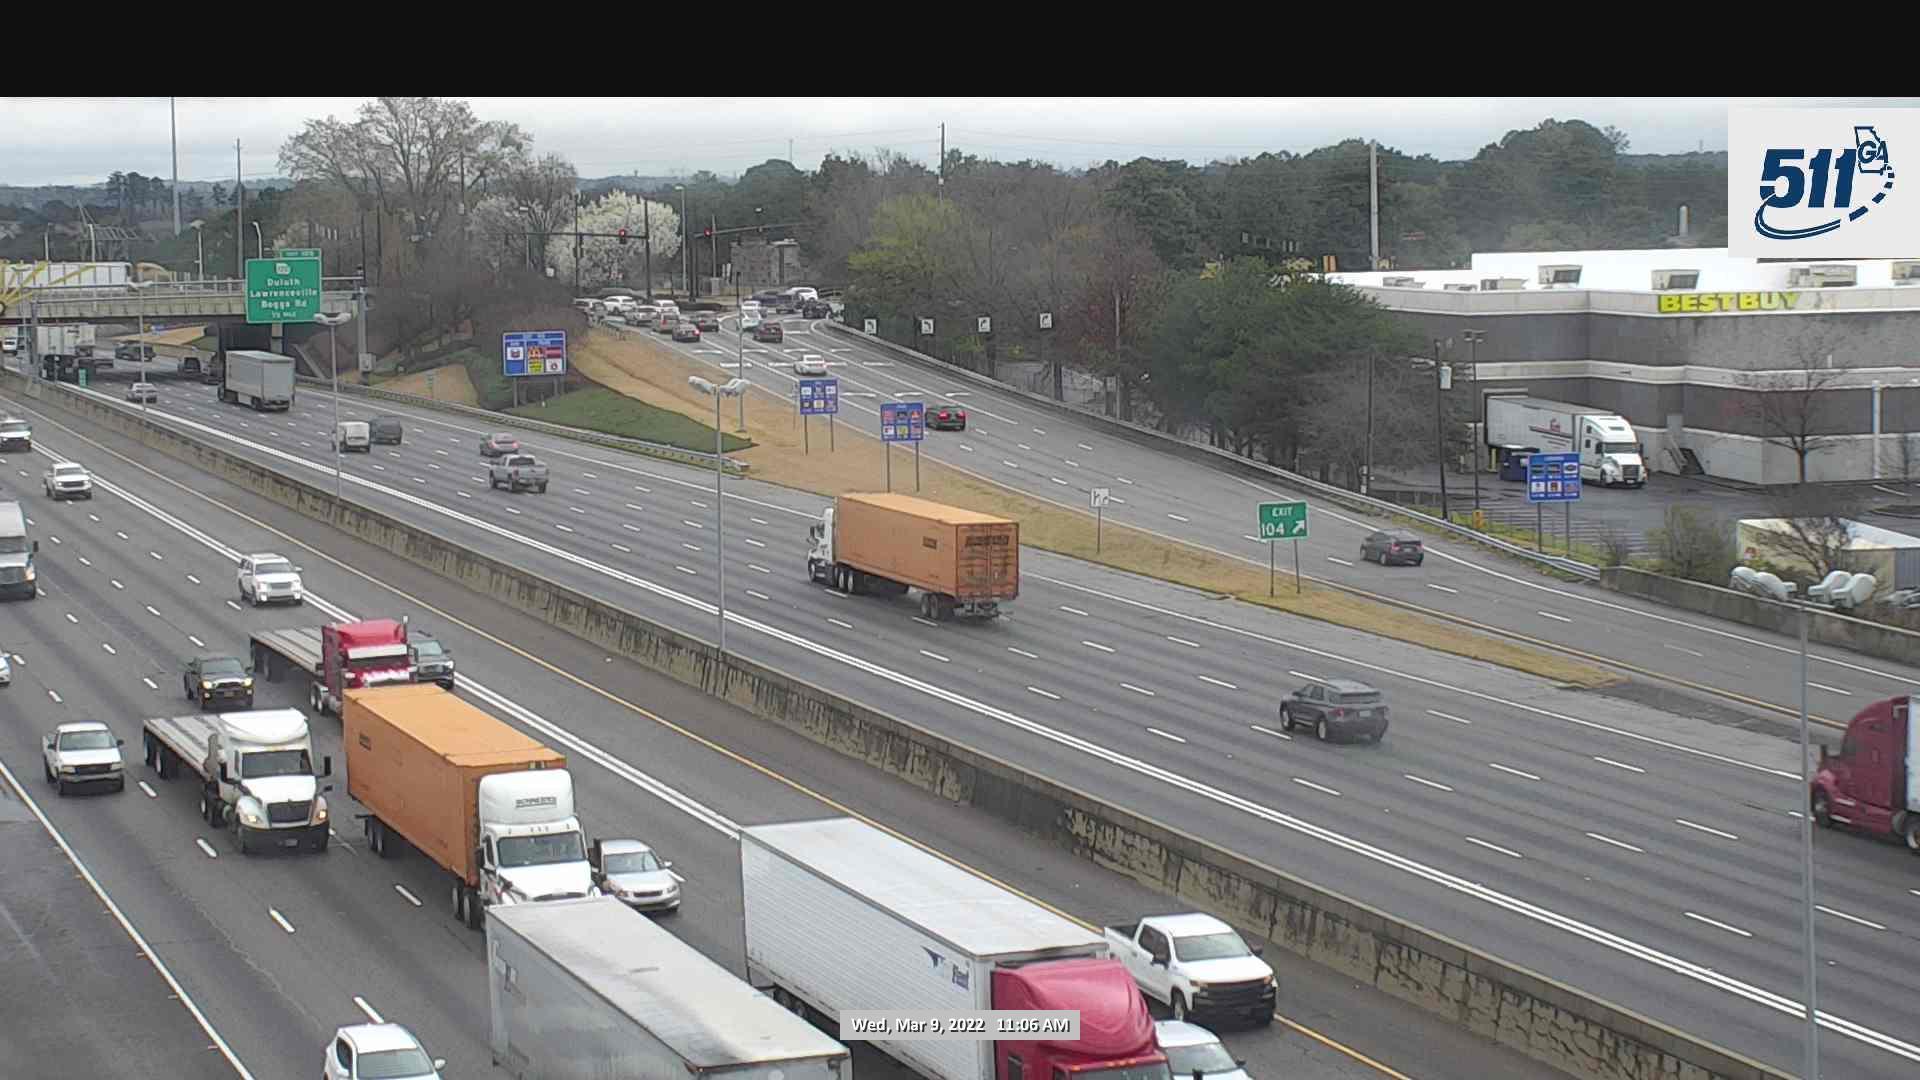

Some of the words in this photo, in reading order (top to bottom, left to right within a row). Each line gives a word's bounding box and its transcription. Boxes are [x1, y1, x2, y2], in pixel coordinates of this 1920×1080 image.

[267, 278, 300, 287] Duluth
[249, 288, 318, 298] Lawrenceville
[1659, 294, 1735, 313] BEST
[1739, 291, 1799, 311] BUY
[1271, 506, 1292, 517] EXIT
[1261, 522, 1284, 537] 104
